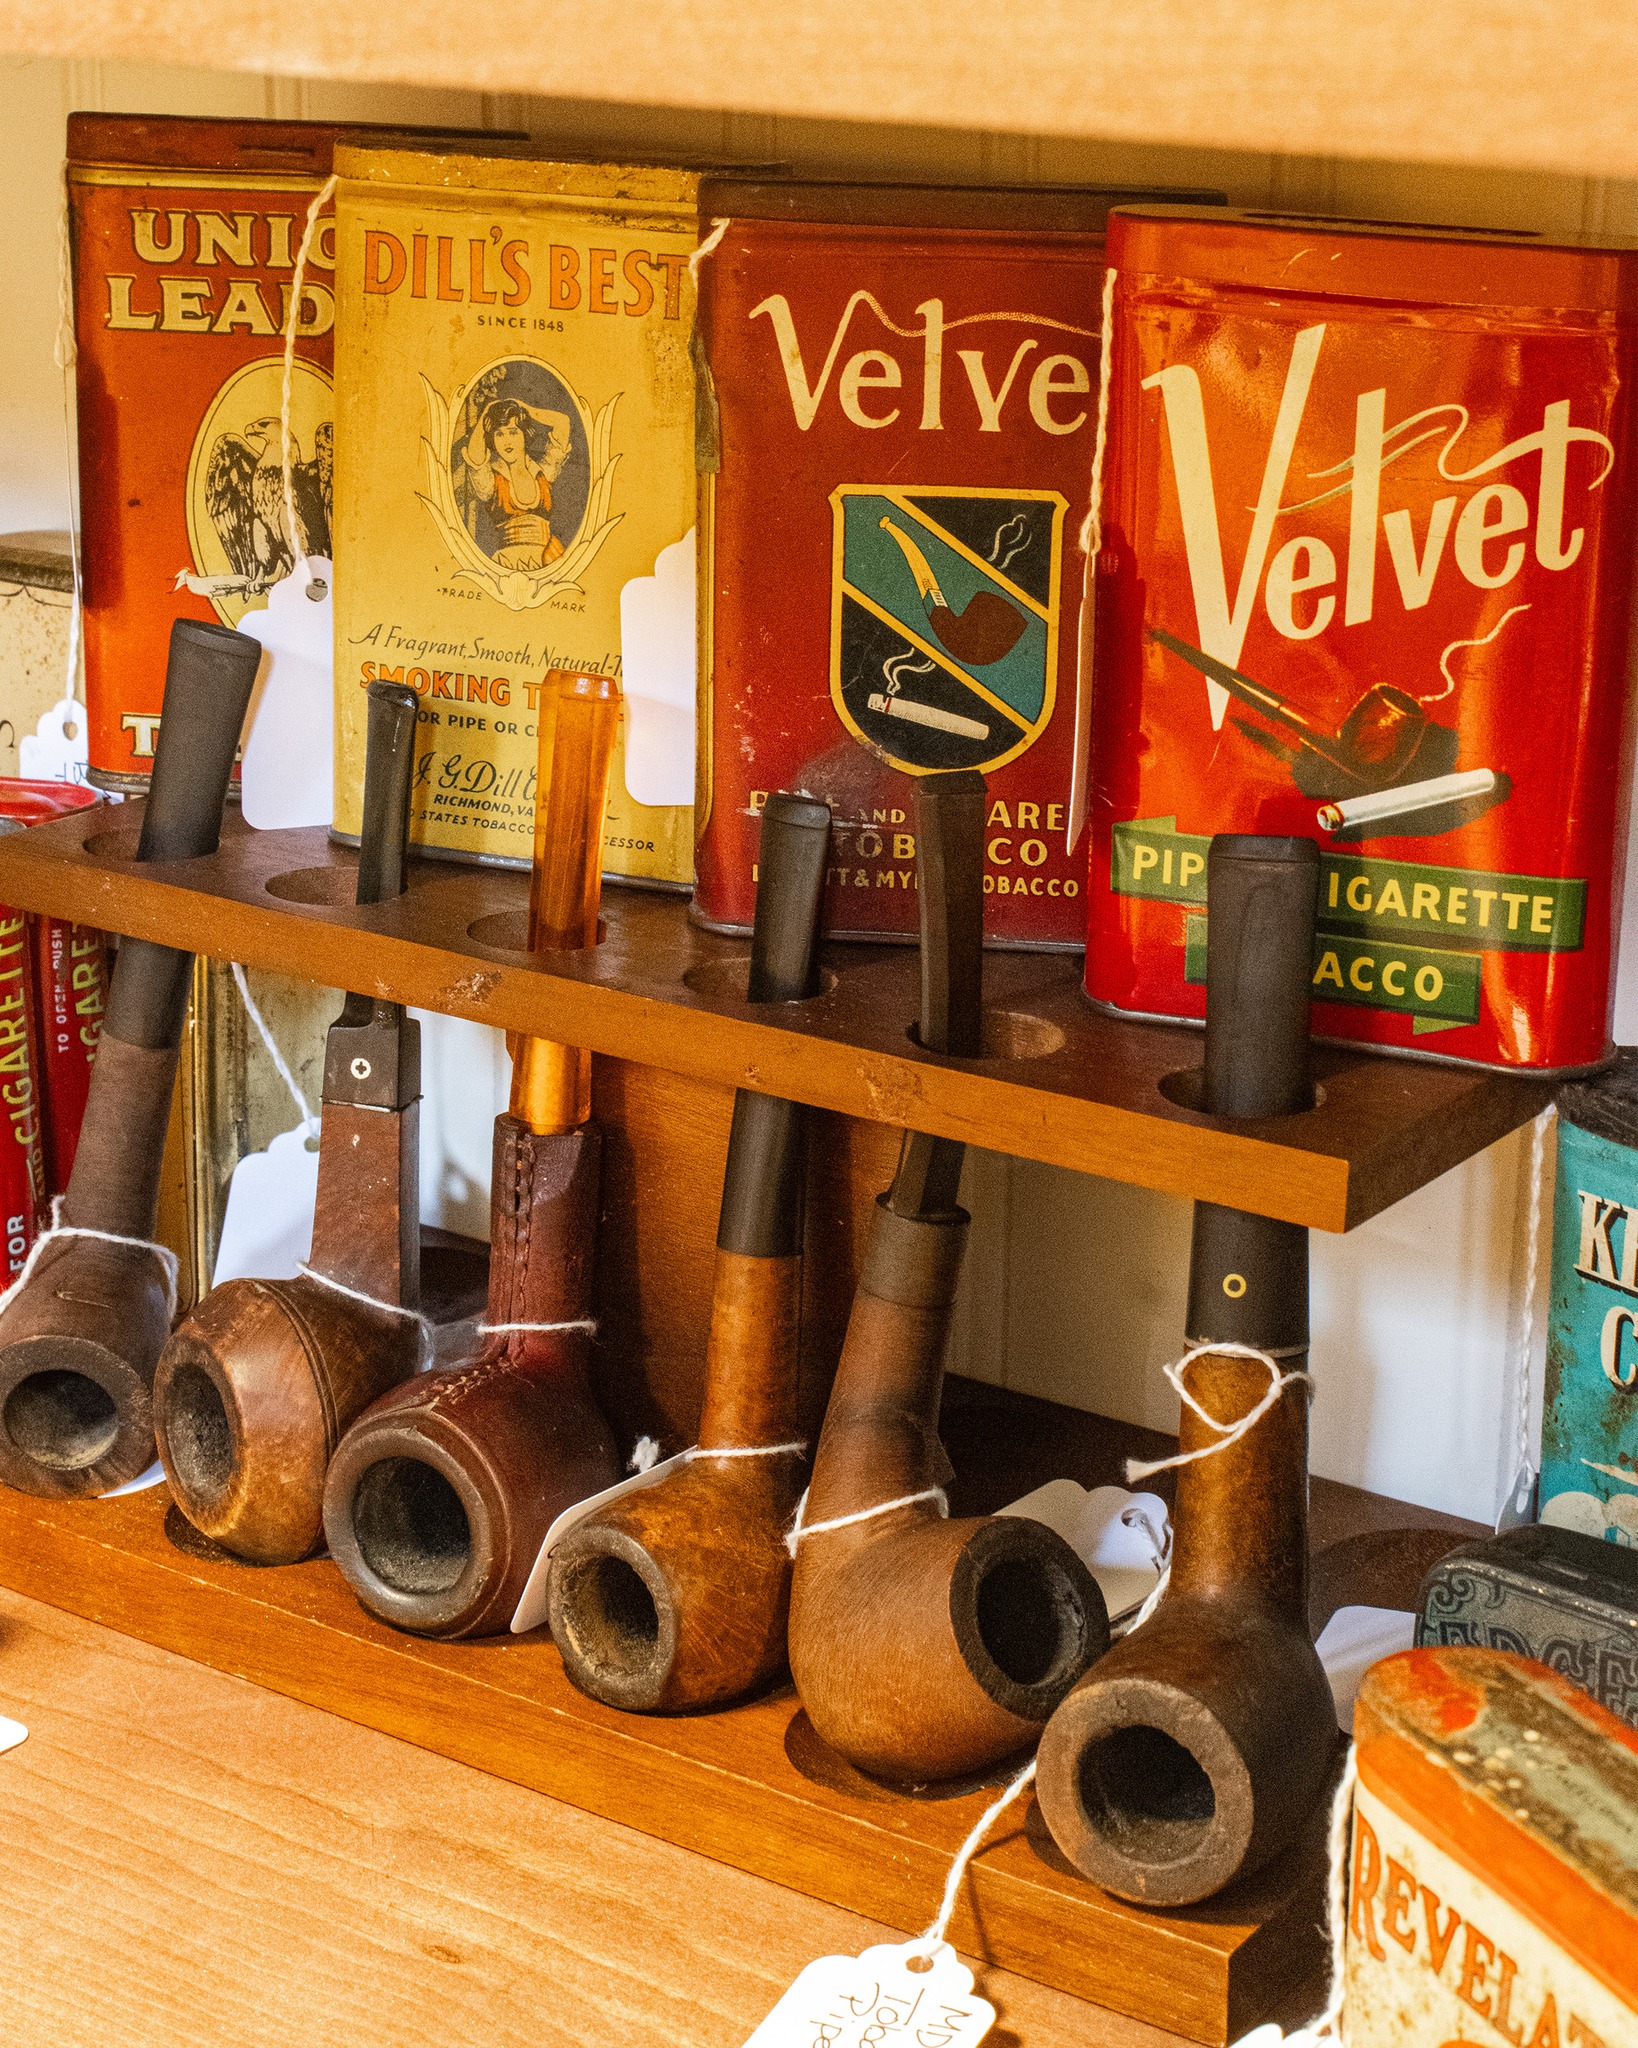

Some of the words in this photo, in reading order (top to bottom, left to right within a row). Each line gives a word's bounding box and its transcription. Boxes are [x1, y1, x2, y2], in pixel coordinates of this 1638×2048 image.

[363, 226, 531, 307] DILL'S
[549, 244, 690, 320] BEST
[477, 315, 527, 329] SINCE
[532, 319, 564, 332] 1848
[749, 290, 1097, 435] Velve
[1141, 323, 1614, 731] Velvet
[550, 601, 586, 612] MARK
[348, 623, 383, 646] A
[360, 661, 511, 706] SMOKING
[417, 710, 440, 725] OR
[448, 714, 486, 731] PIPE
[494, 721, 518, 736] OR
[434, 793, 514, 816] RICHMOND,
[420, 810, 468, 825] STATES
[473, 817, 536, 835] TOBACCO
[983, 875, 1079, 898] OBACCO
[1132, 845, 1206, 888] PIP
[1328, 872, 1554, 934] IGARETTE
[1312, 951, 1443, 1002] ACCO
